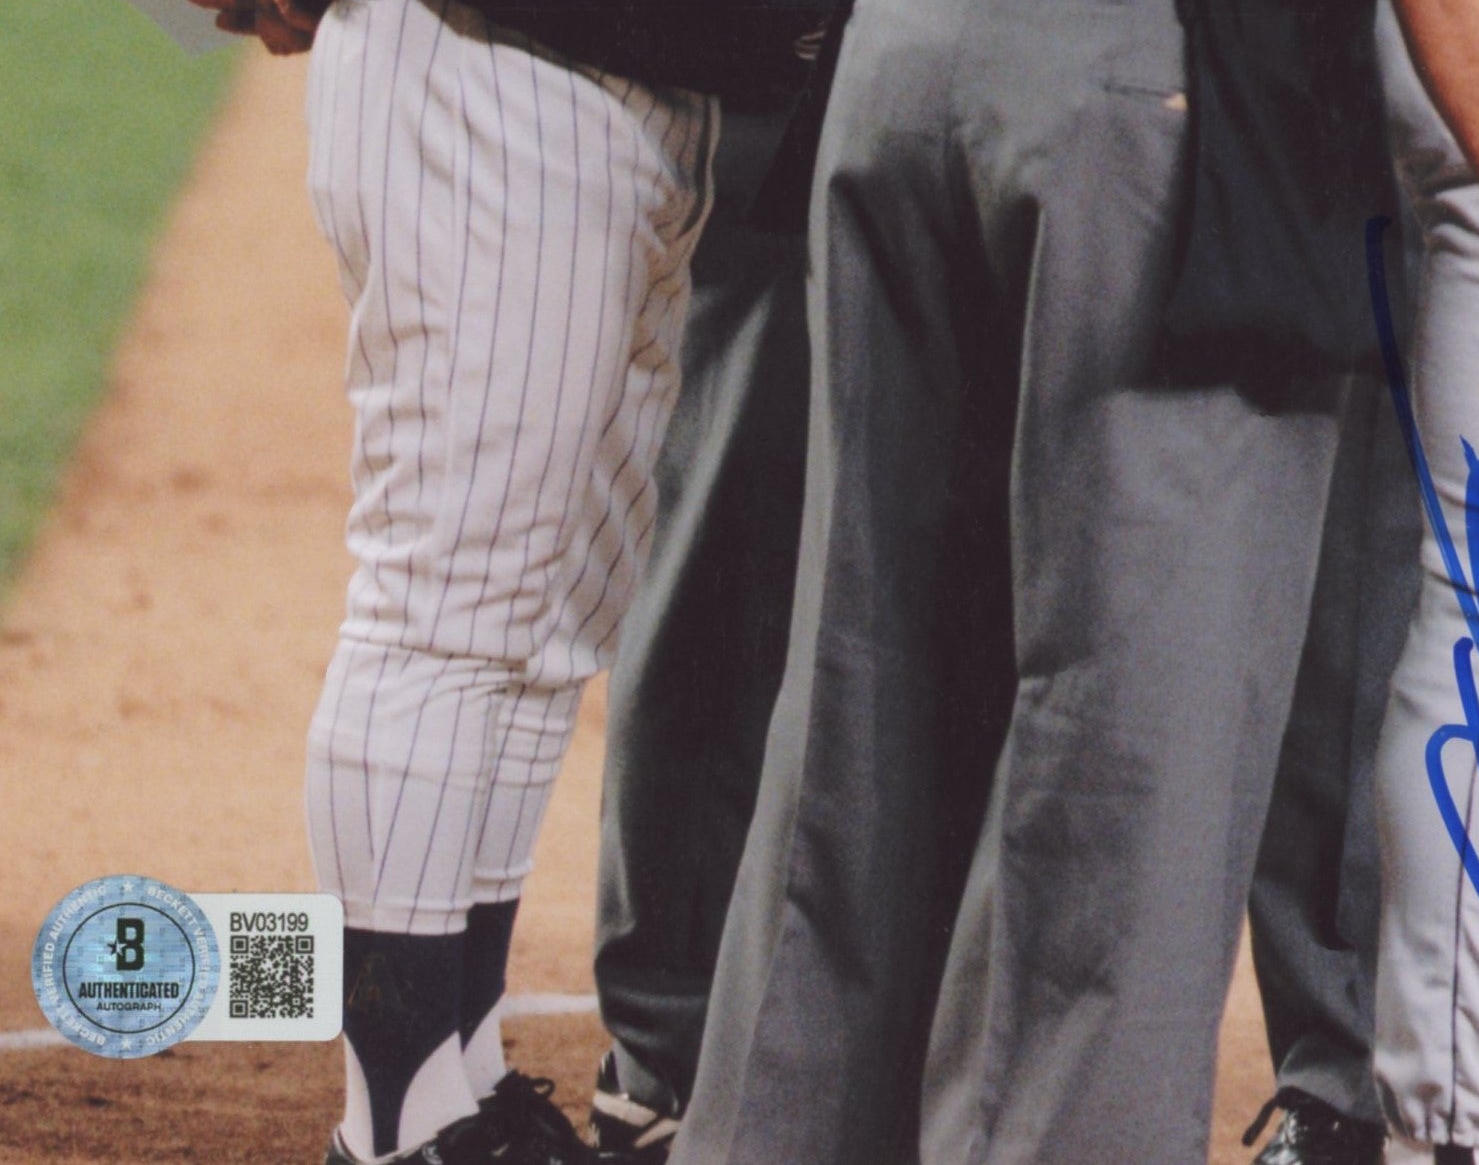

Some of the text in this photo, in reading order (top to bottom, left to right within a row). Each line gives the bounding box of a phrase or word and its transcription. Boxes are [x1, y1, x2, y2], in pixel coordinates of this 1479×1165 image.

[230, 913, 309, 932] BV03199
[115, 917, 146, 972] B
[78, 982, 180, 1000] AUTHENTICATED
[96, 1002, 162, 1012] AUTOGRAPH
